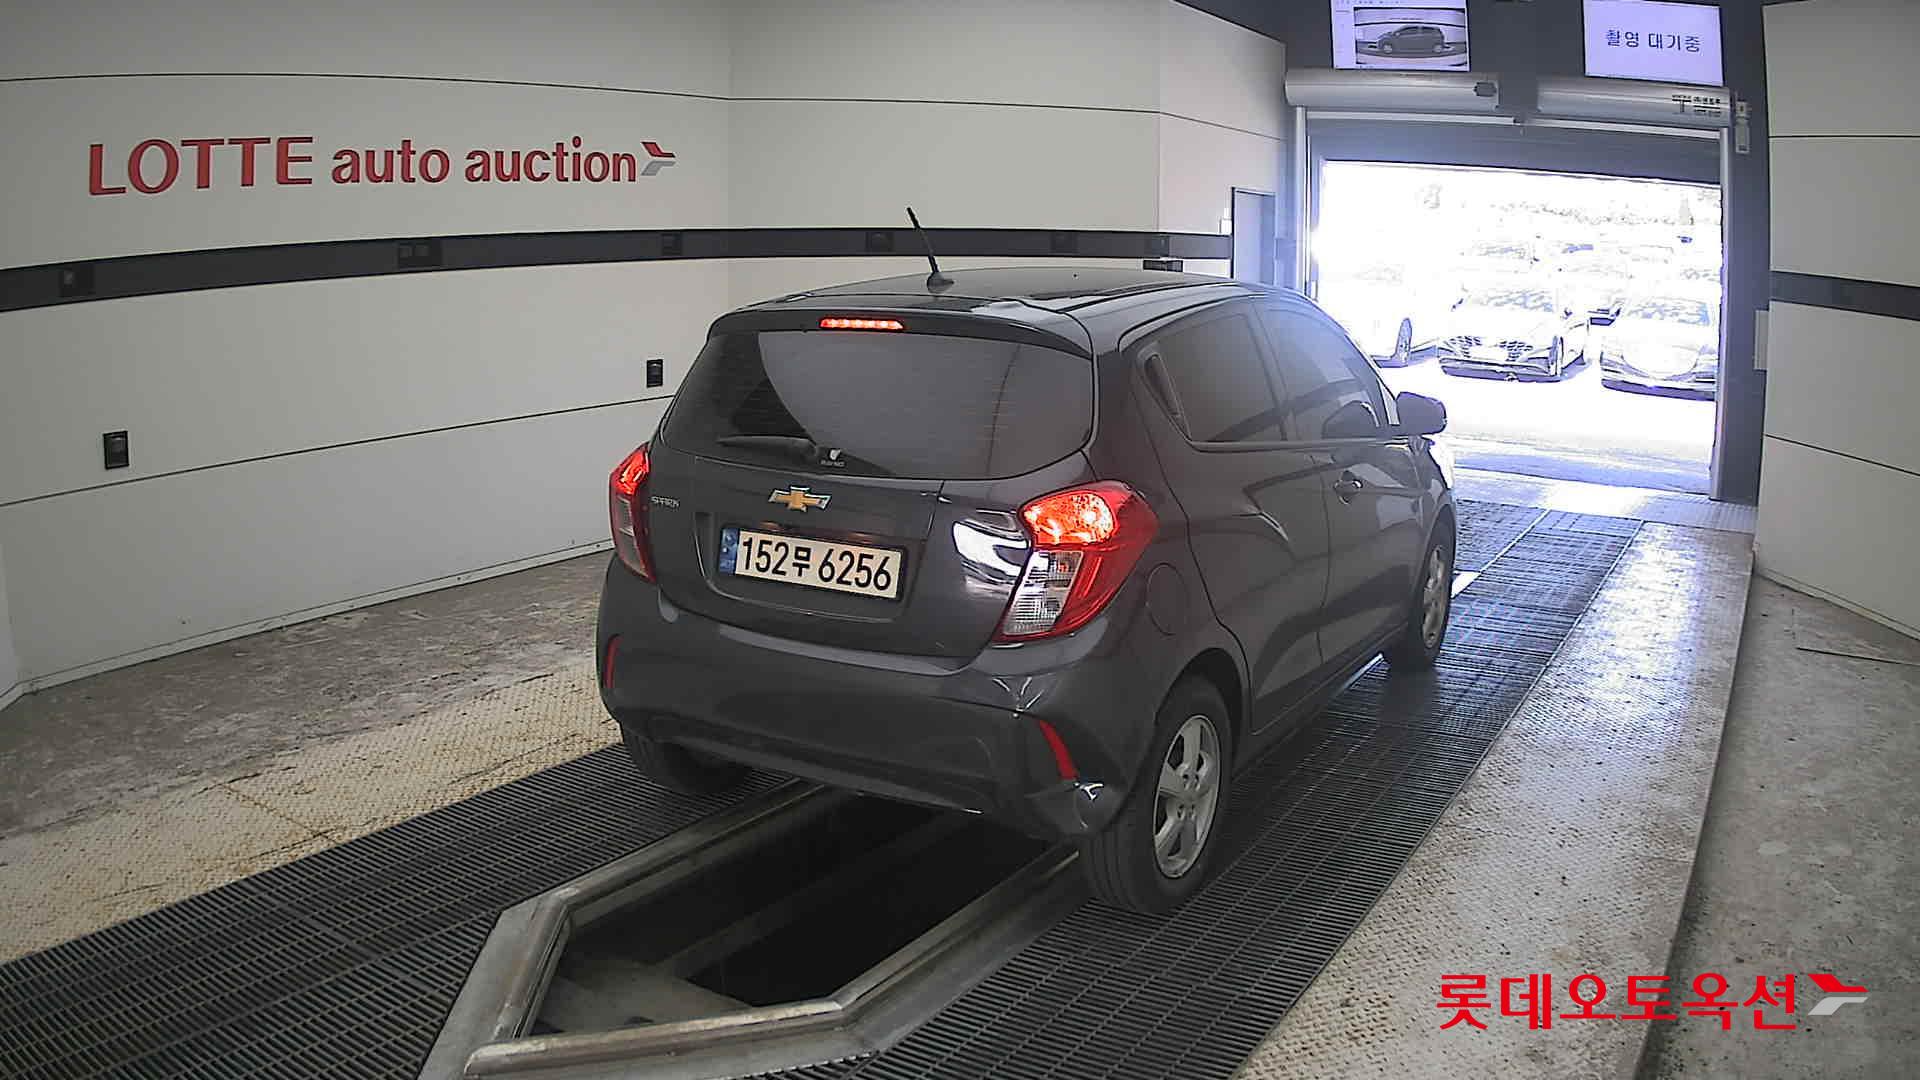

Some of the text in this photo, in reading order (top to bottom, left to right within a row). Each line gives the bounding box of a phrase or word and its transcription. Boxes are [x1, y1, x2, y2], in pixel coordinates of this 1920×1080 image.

[1607, 29, 1701, 53] 촬영 대기중
[88, 136, 638, 196] LOTTE auto auction
[742, 537, 891, 591] 152무 6256
